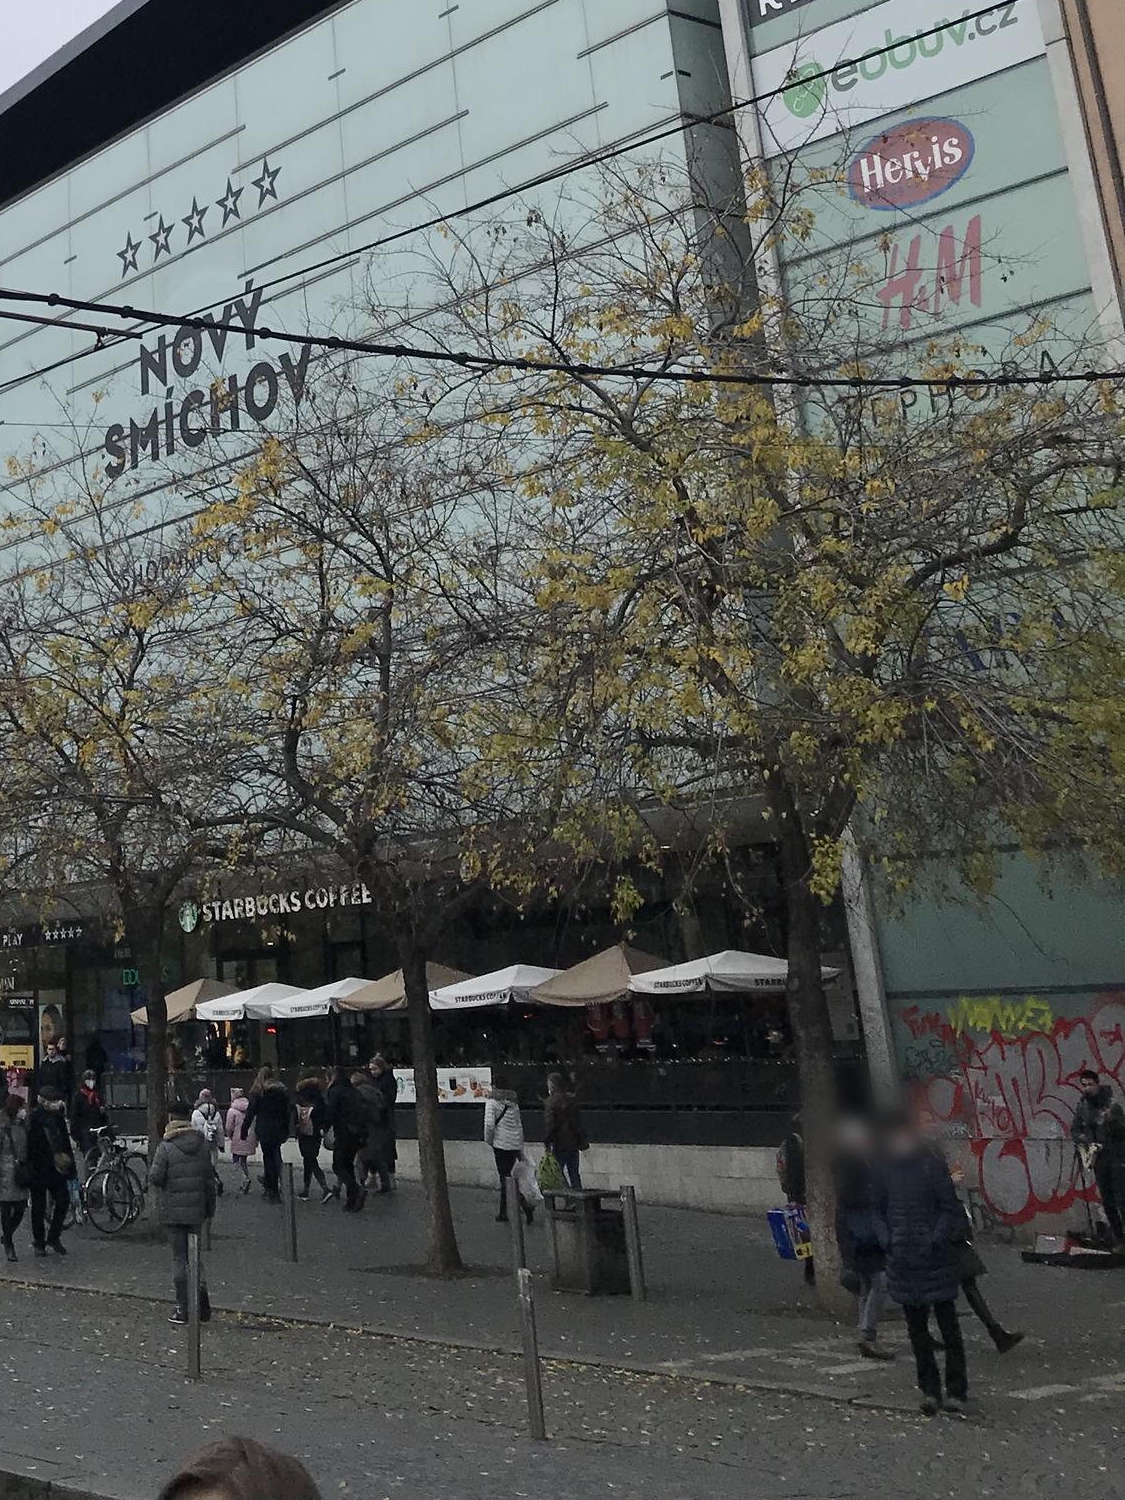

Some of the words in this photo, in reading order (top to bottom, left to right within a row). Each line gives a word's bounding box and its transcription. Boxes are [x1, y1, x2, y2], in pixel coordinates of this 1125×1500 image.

[860, 135, 963, 193] Hervis
[139, 279, 263, 396] NOVÝ
[104, 343, 311, 479] SMÍCHOV
[202, 890, 302, 922] STARBUCKS
[304, 883, 373, 910] COFFEE
[2, 933, 23, 948] PLAY
[754, 978, 786, 987] STARB
